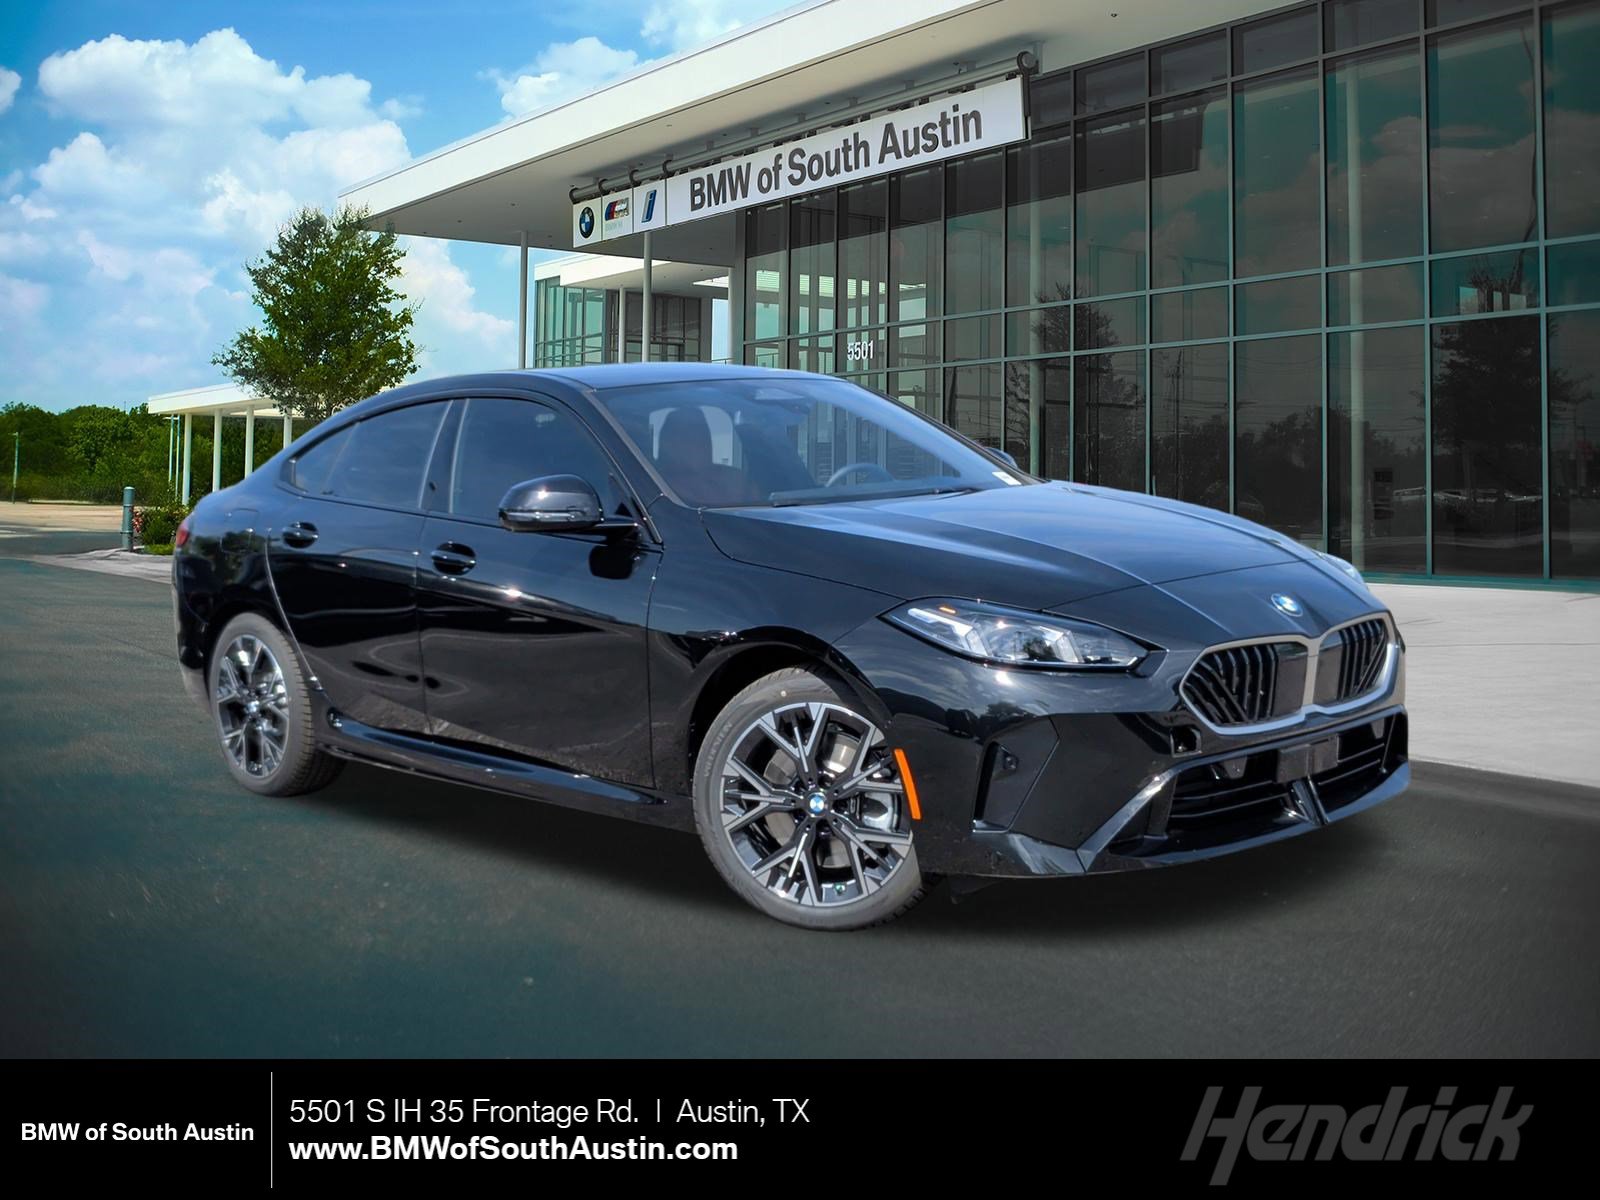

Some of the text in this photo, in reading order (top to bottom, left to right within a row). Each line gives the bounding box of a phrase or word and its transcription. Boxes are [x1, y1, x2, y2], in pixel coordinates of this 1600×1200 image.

[690, 162, 752, 212] BMW
[757, 153, 783, 194] of
[787, 131, 870, 186] South
[878, 103, 982, 164] Austin
[847, 340, 873, 361] 5501
